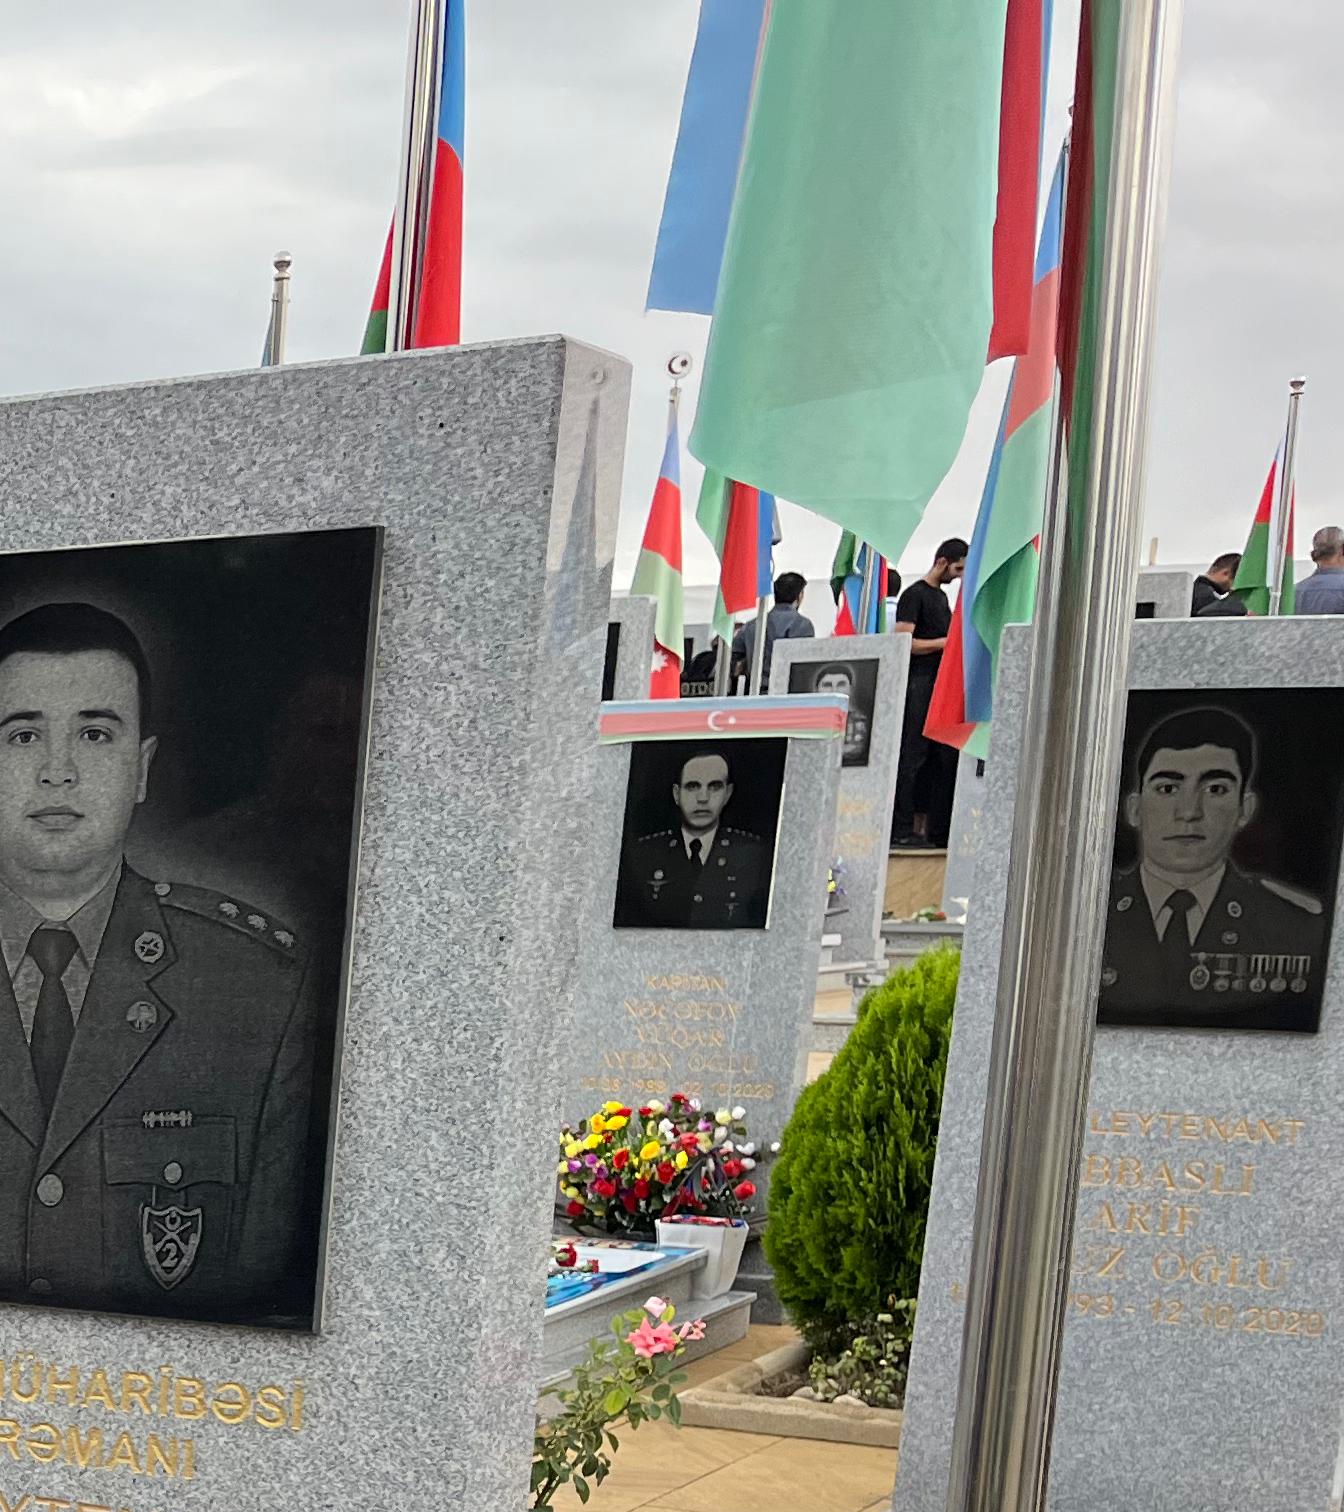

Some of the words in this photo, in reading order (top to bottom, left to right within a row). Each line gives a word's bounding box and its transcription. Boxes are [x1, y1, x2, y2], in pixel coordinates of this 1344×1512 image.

[1089, 1110, 1306, 1145] LEYTENANT
[1081, 1152, 1256, 1197] BBASLI
[1087, 1199, 1201, 1237] ARİF
[161, 1243, 178, 1268] 2
[1151, 1246, 1295, 1291] OĞLU
